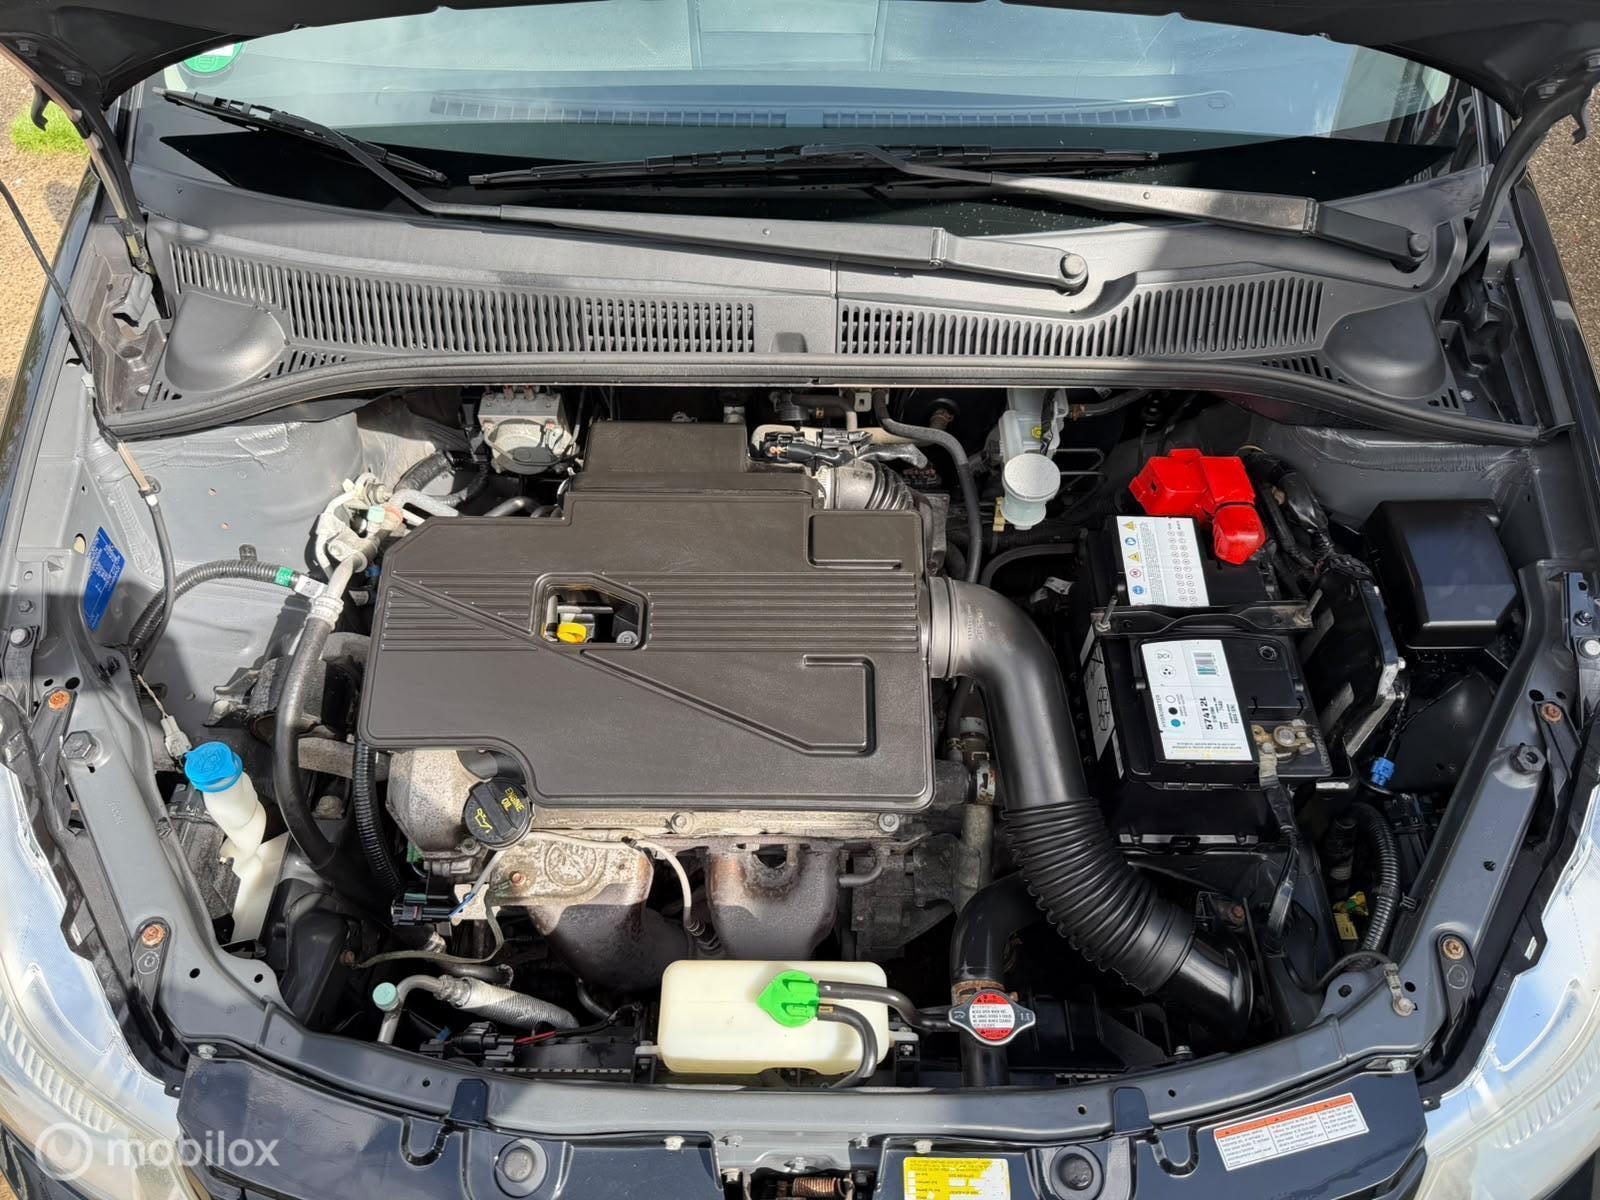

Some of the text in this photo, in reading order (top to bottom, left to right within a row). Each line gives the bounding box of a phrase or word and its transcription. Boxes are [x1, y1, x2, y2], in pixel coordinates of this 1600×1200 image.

[1200, 696, 1213, 730] 57412L
[501, 797, 512, 812] OIL
[505, 787, 525, 812] ENGINE
